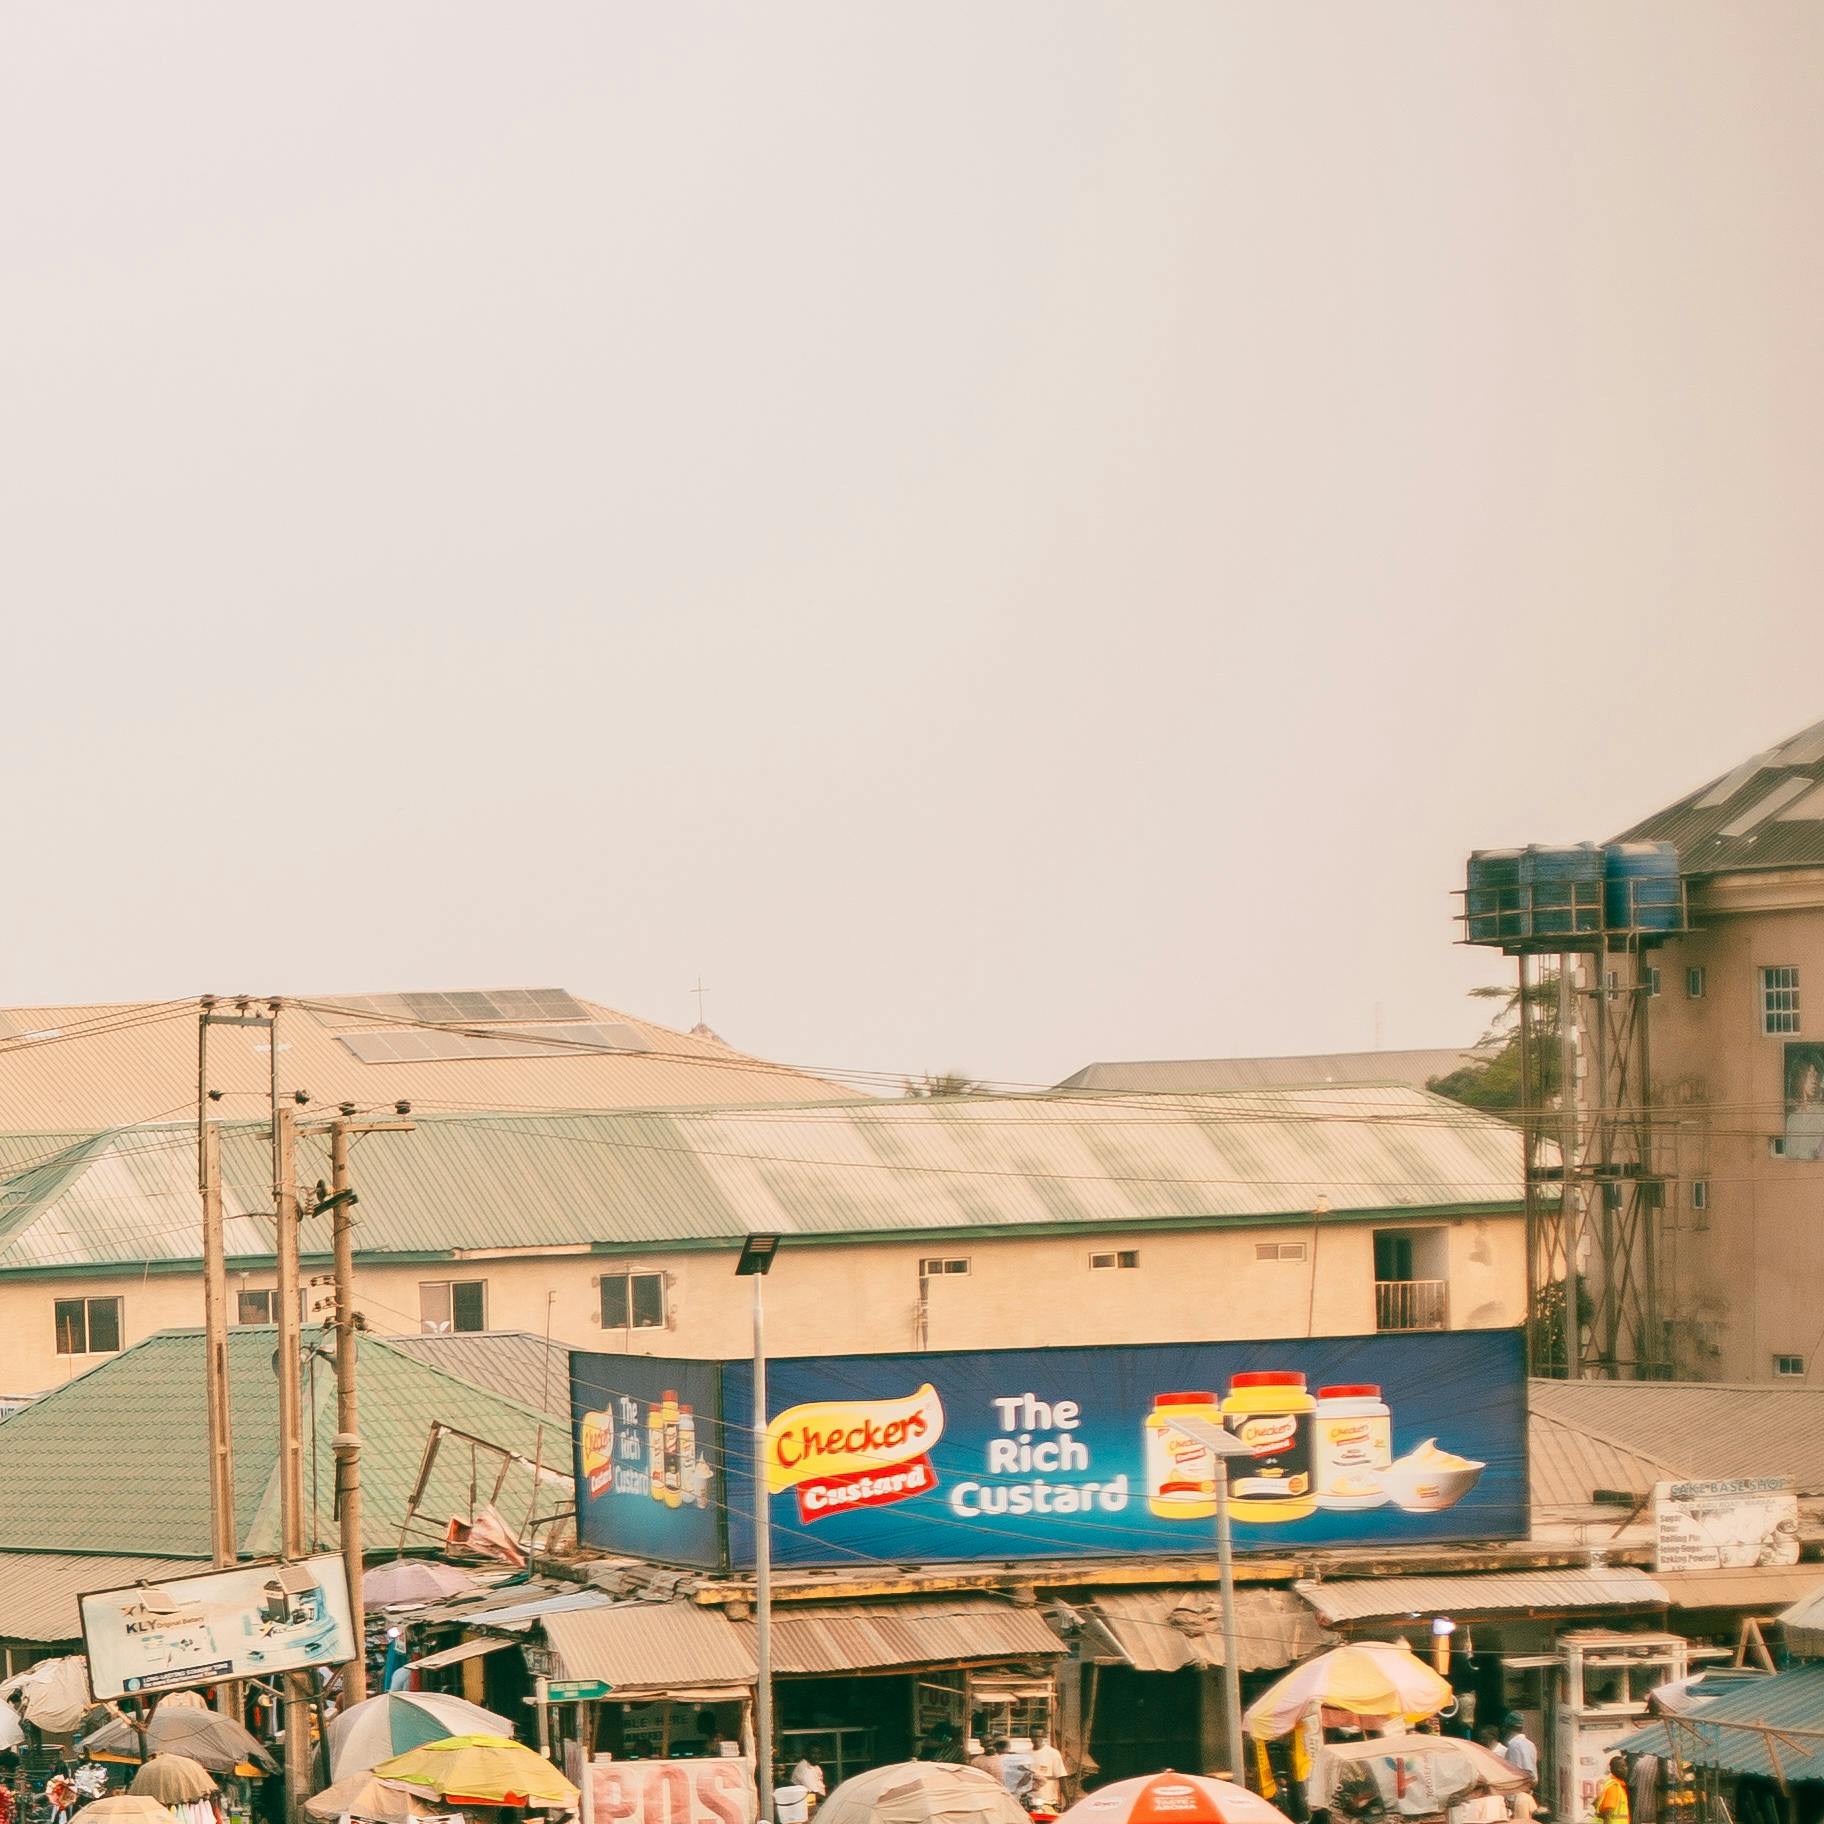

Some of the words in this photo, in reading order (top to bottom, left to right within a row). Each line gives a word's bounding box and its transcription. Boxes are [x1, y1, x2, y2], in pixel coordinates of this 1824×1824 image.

[619, 1396, 638, 1424] The
[994, 1393, 1080, 1432] The
[619, 1432, 641, 1461] Rich
[777, 1411, 927, 1469] Checkers
[989, 1434, 1089, 1476] Rich
[804, 1465, 926, 1509] Custard
[951, 1476, 1128, 1518] Custard
[1711, 1479, 1745, 1493] BASE
[126, 1618, 157, 1634] KLY
